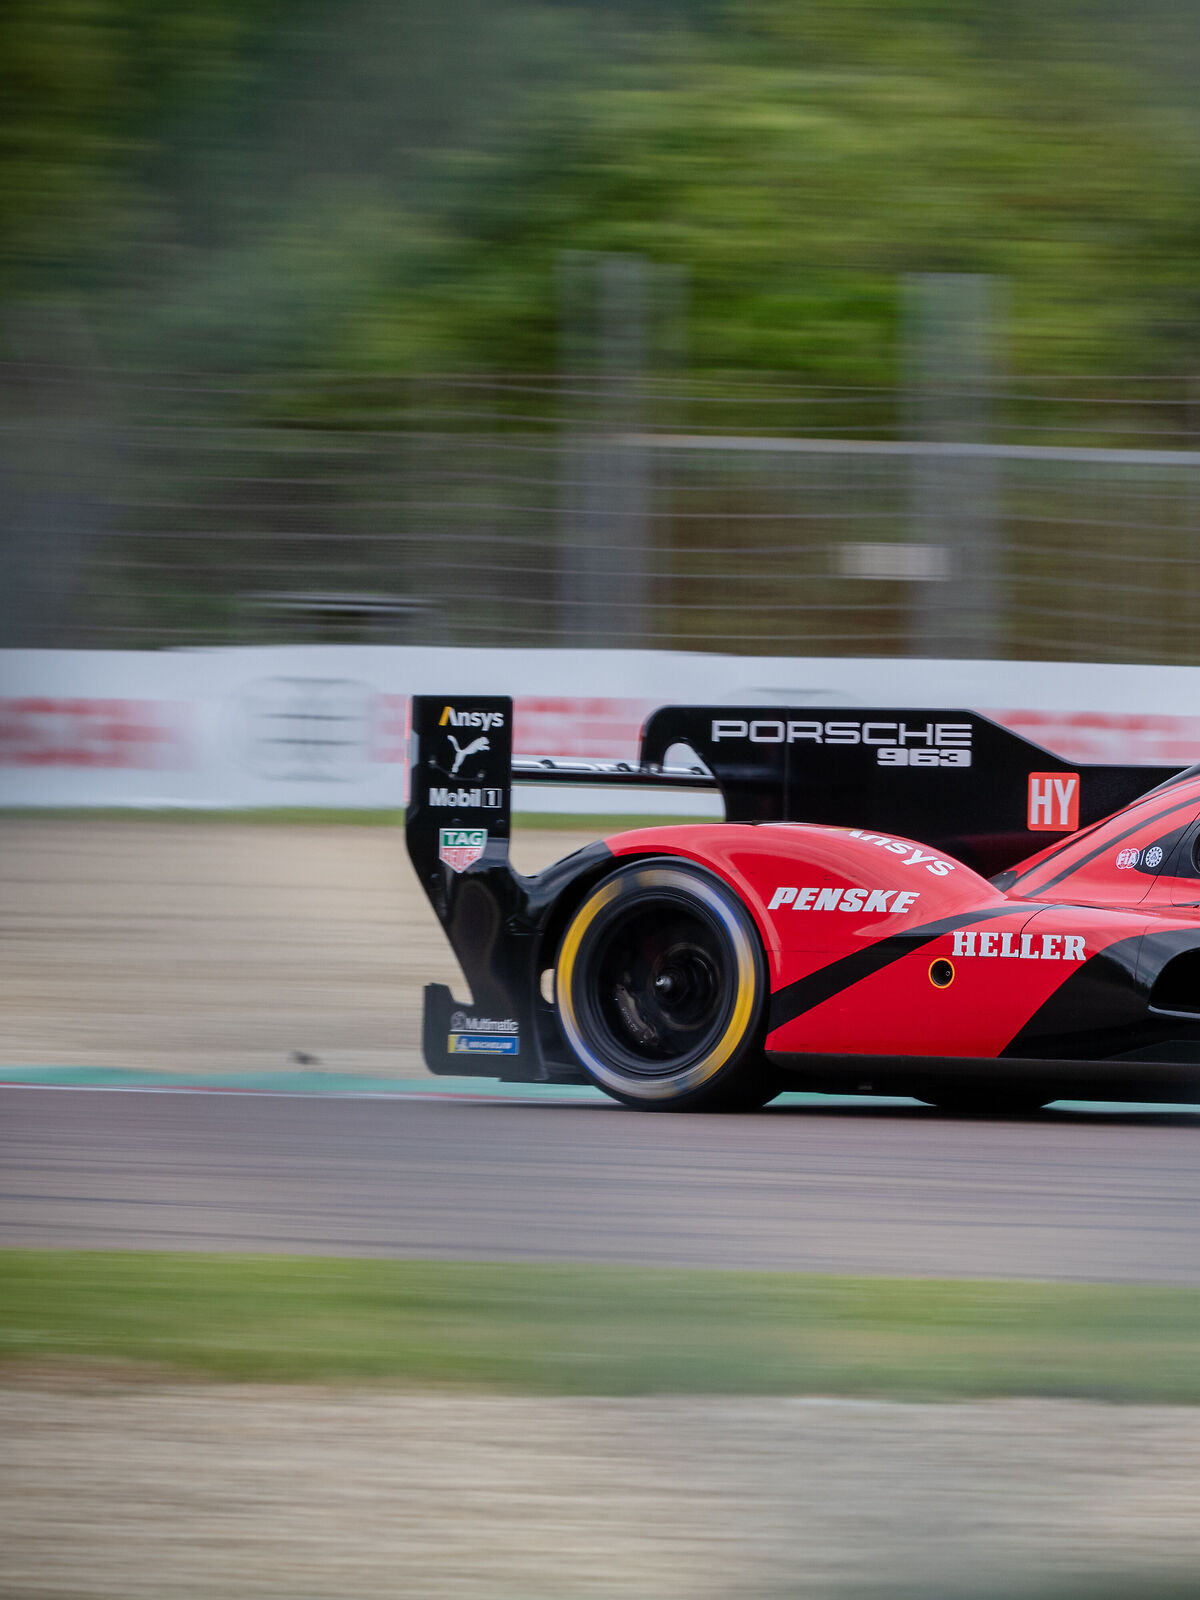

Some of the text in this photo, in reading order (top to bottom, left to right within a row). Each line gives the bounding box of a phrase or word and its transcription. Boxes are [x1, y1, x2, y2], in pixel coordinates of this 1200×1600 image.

[438, 706, 504, 731] Ansys
[711, 720, 972, 747] PORSCHE
[877, 748, 971, 767] 963
[428, 788, 481, 807] Mobil
[1030, 779, 1076, 825] HY
[444, 832, 483, 846] TAG
[1117, 850, 1138, 866] FIA
[768, 887, 920, 914] PENSKE
[952, 931, 1087, 961] HELLER
